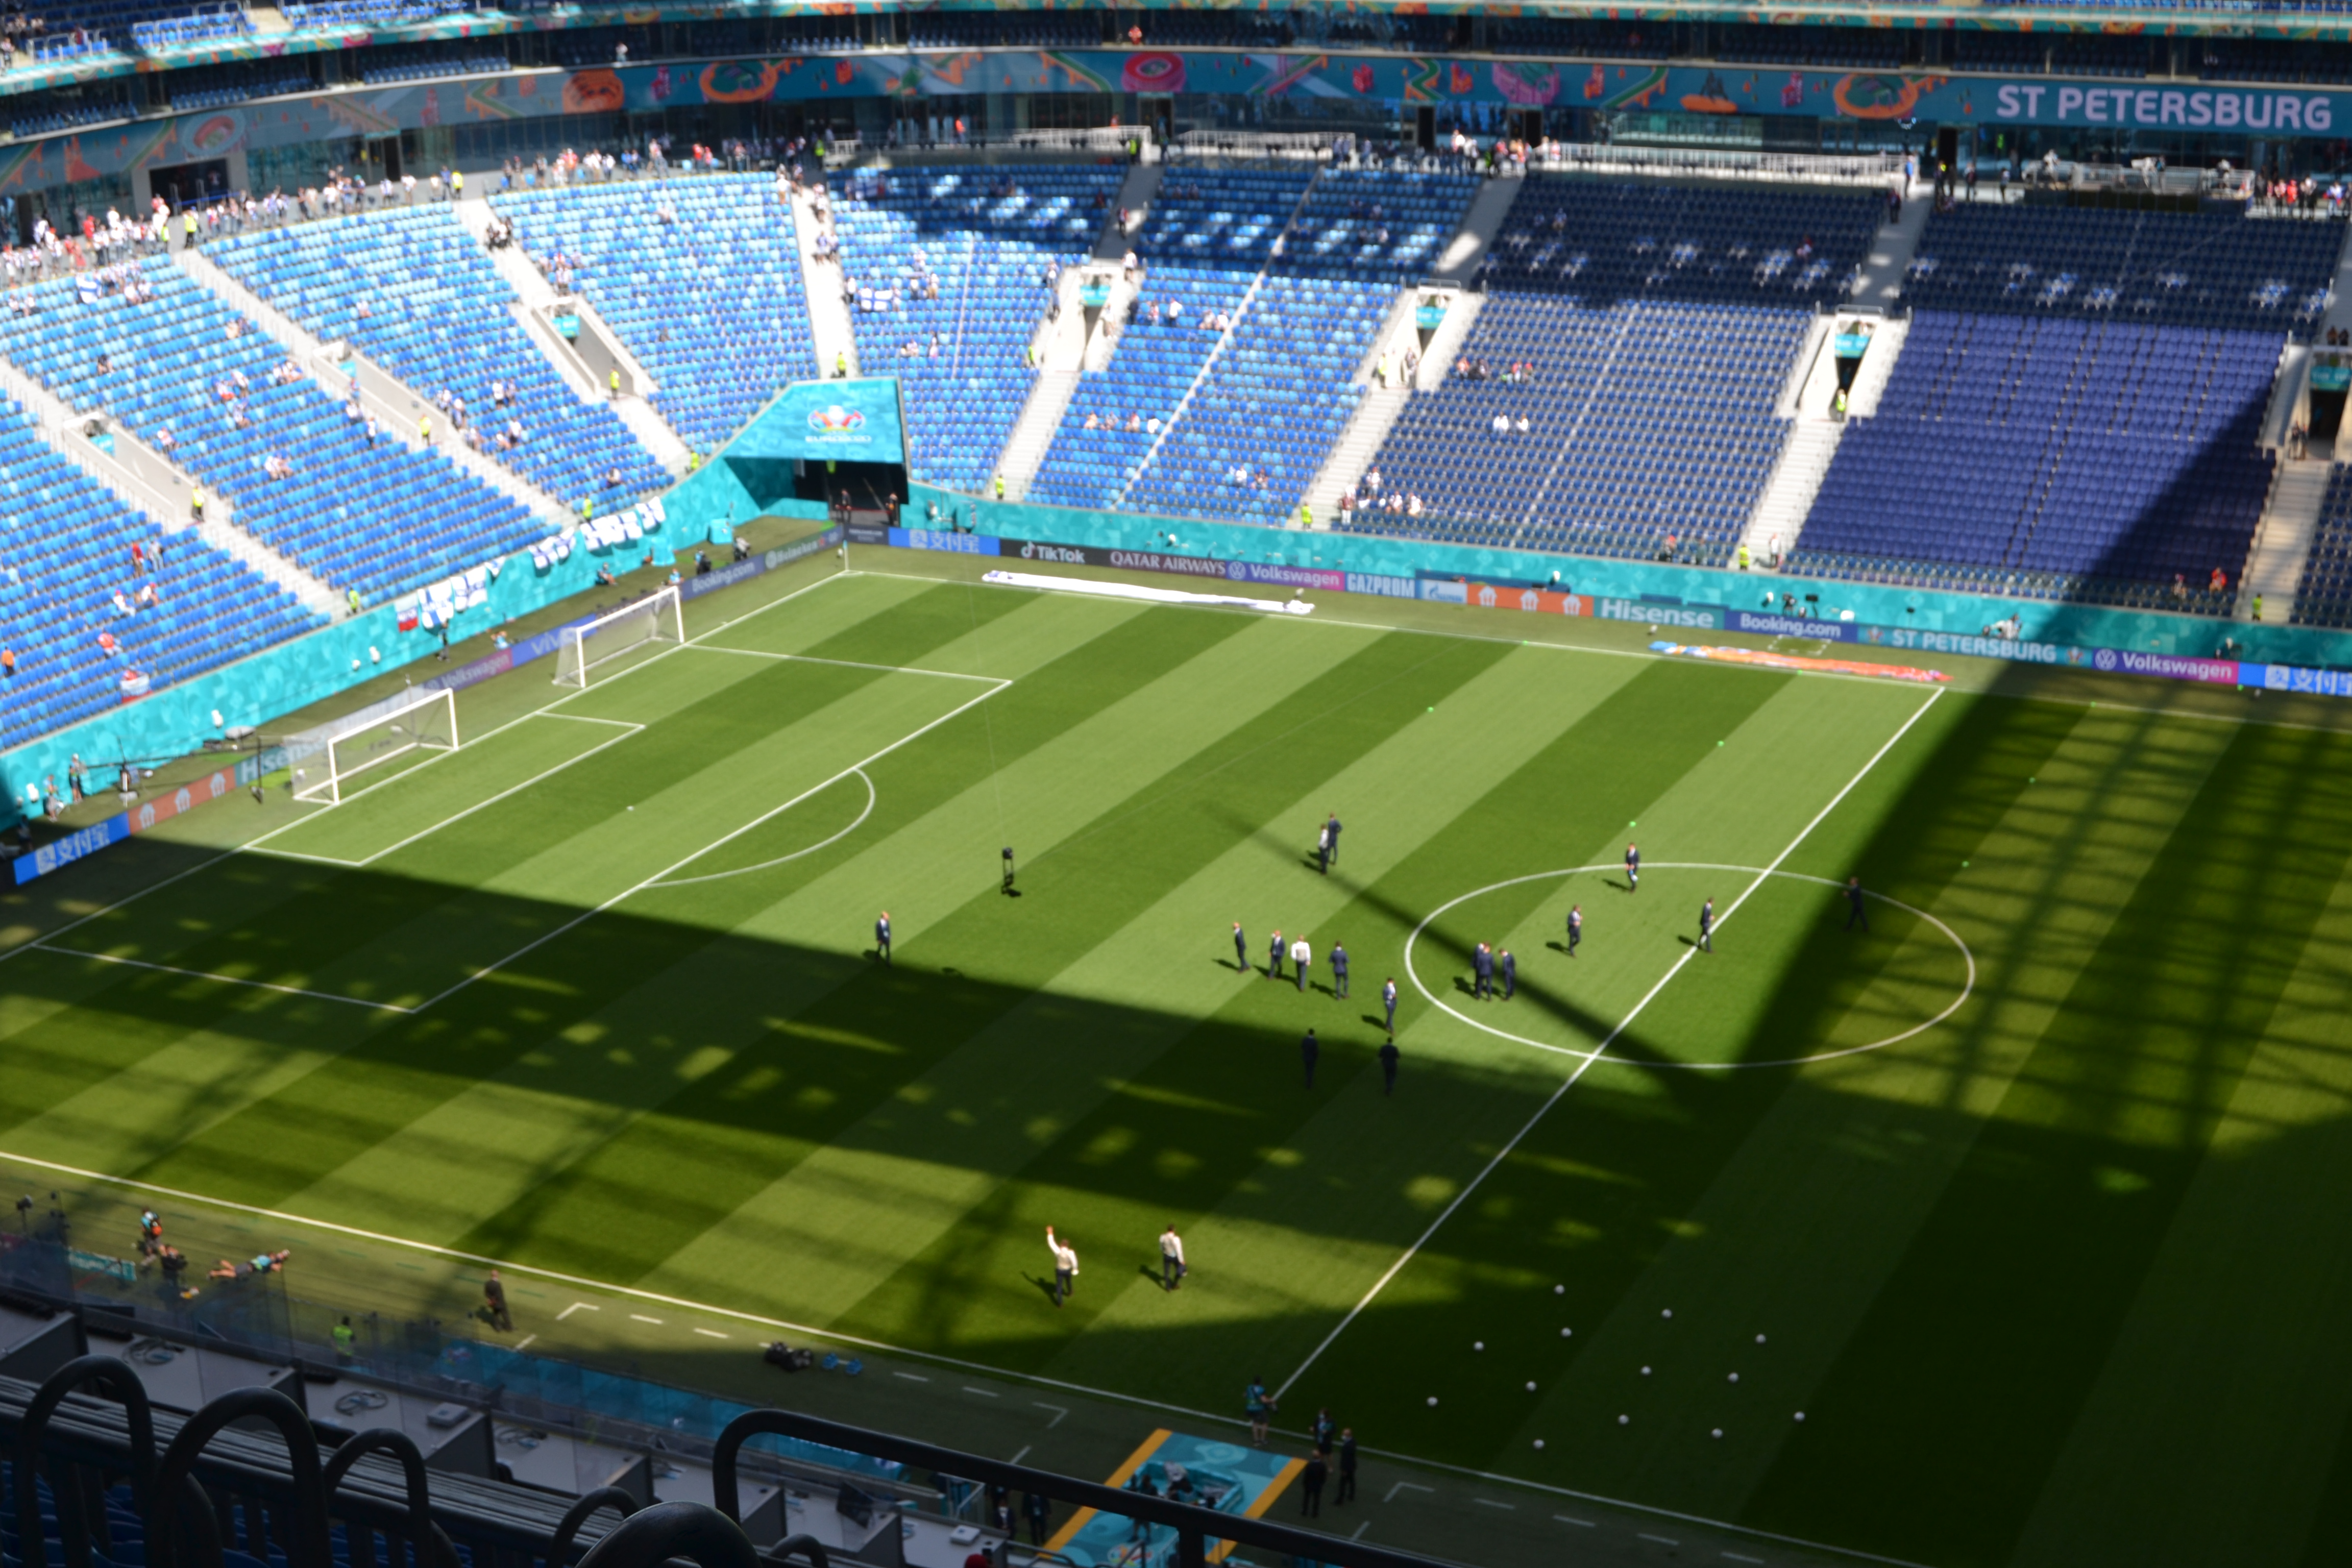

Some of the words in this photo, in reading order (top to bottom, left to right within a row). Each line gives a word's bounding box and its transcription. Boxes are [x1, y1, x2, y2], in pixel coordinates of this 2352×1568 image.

[1996, 85, 2045, 119] ST
[2057, 88, 2332, 131] PETERSBURG
[931, 530, 979, 554] 支付宝
[1037, 545, 1086, 564] TikTok
[1110, 550, 1160, 570] QATAR
[1163, 553, 1226, 575] AIRWAYS
[1251, 564, 1340, 588] Volkswagen
[692, 562, 755, 593] Booking.com
[1347, 573, 1415, 598] GAZPROM
[1601, 598, 1714, 628] Hisense
[1739, 613, 1841, 641] Booking.com
[1893, 630, 1923, 648] ST
[1925, 632, 2056, 663] PETERSBURG
[441, 654, 508, 689] Volkswagen
[2122, 651, 2233, 680] Volkswagen
